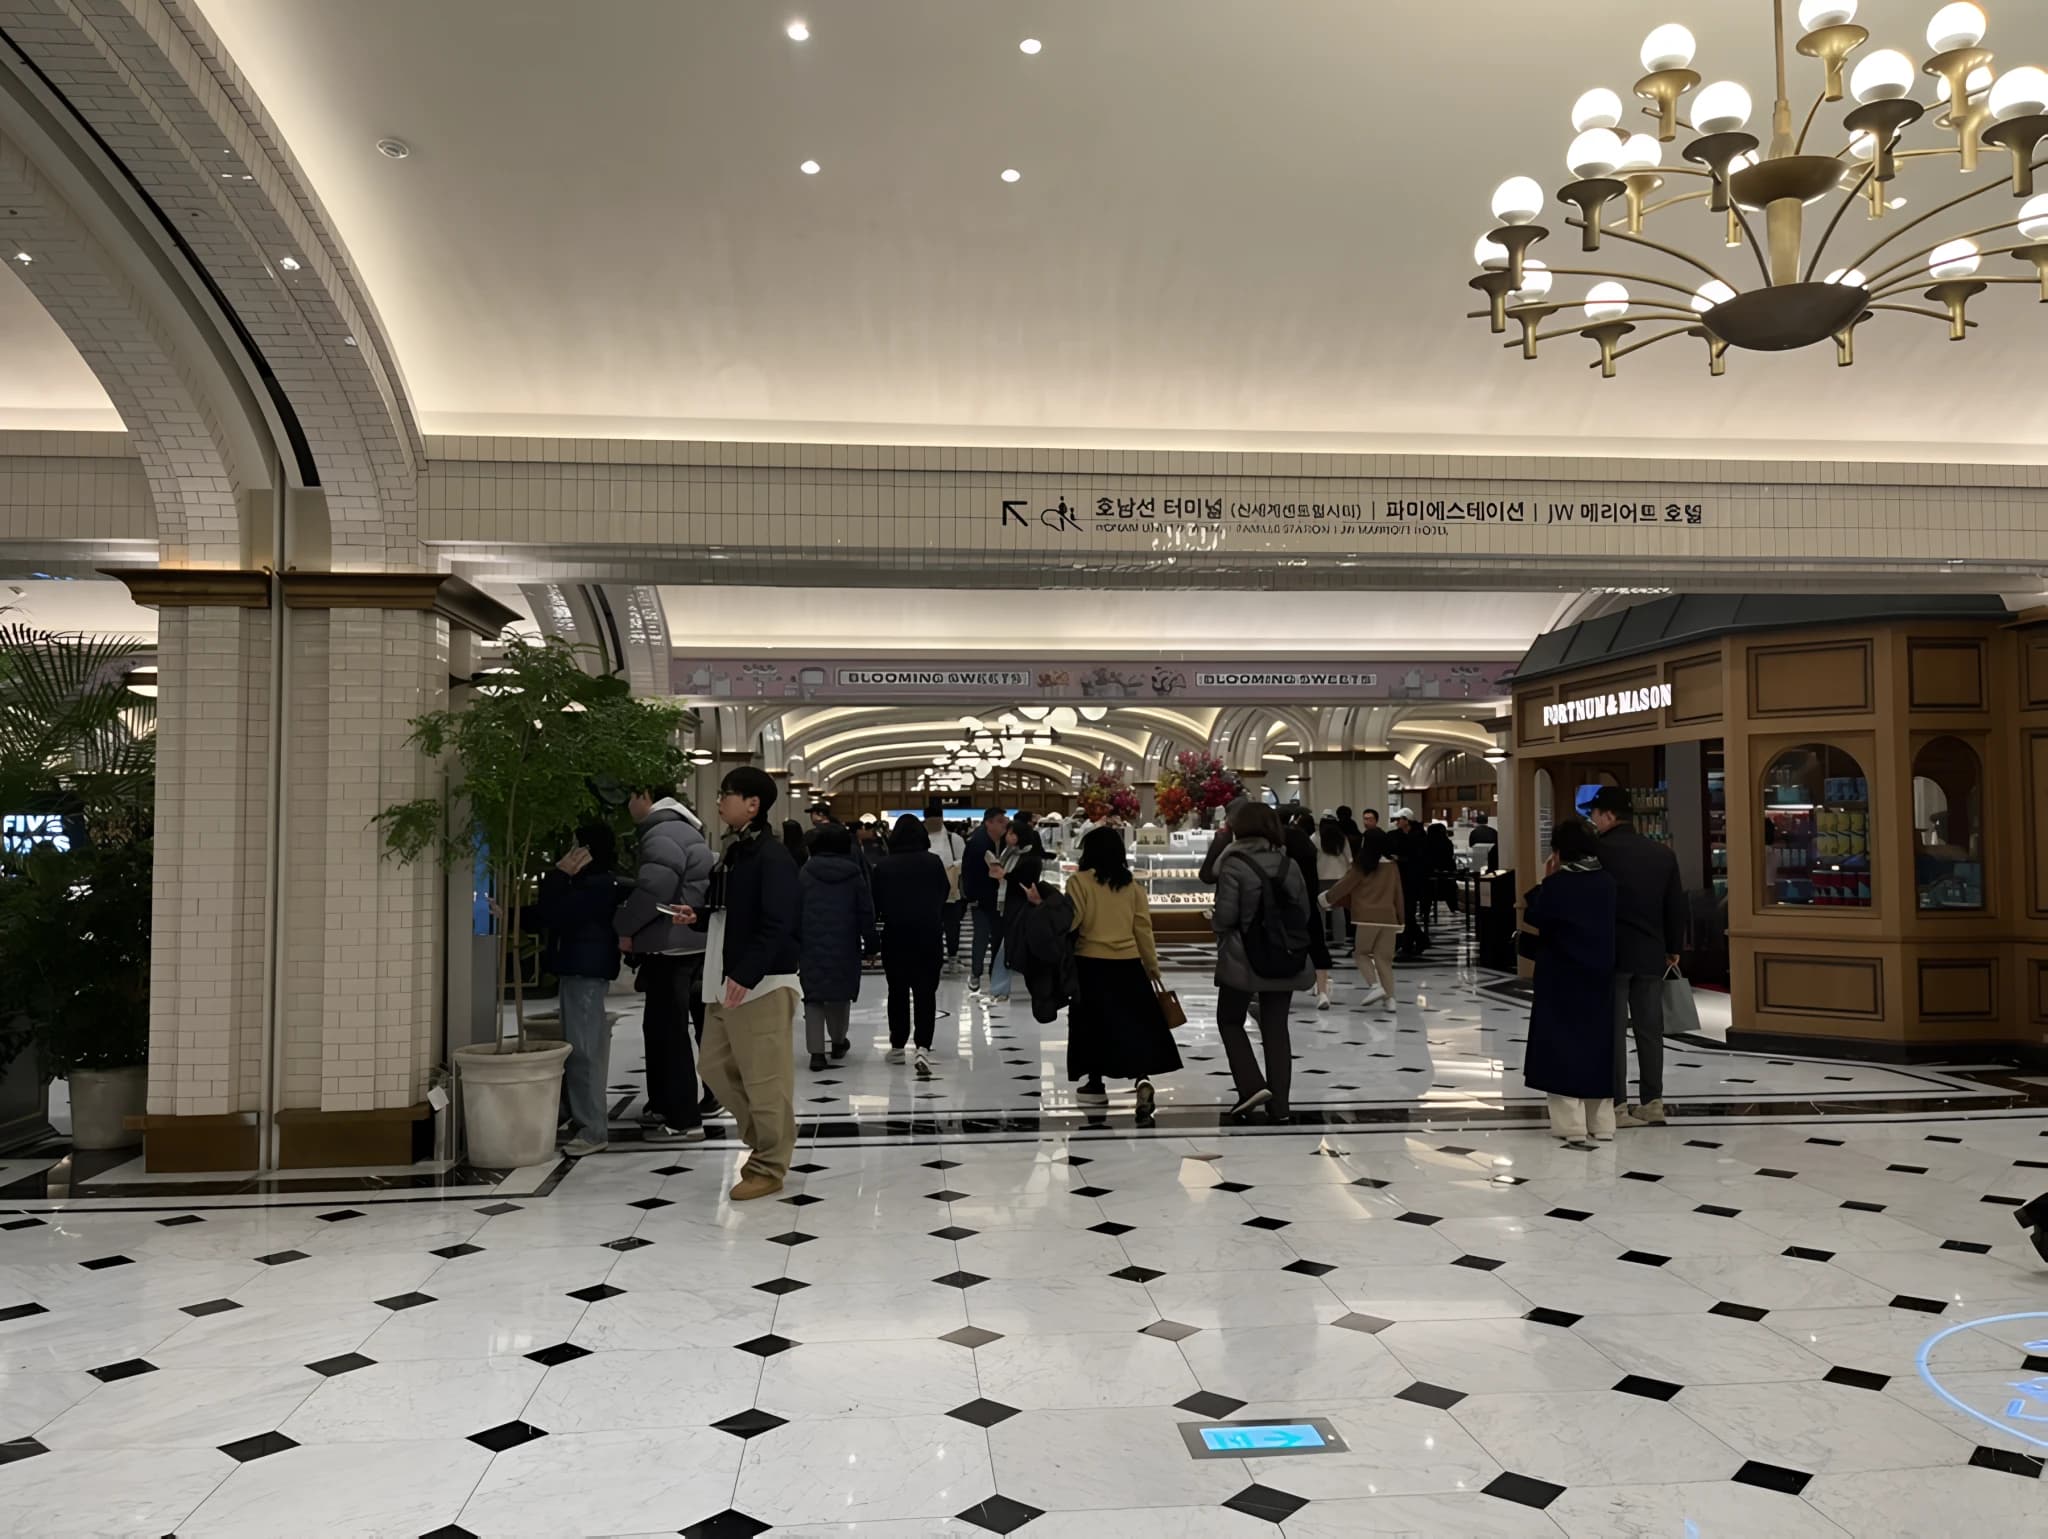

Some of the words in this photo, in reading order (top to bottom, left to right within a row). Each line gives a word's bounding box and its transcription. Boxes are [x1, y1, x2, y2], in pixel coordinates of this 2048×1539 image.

[1096, 497, 1155, 518] 호남선
[1164, 497, 1222, 519] 터미널
[1386, 500, 1524, 521] 파미에스테이션
[1548, 503, 1574, 523] JW
[848, 673, 944, 684] BLOOMING
[1203, 675, 1296, 684] BLOOMING
[1544, 695, 1606, 726] FORTNUM
[1606, 693, 1618, 715] &
[1618, 683, 1671, 714] MASON
[3, 815, 63, 833] FIVE
